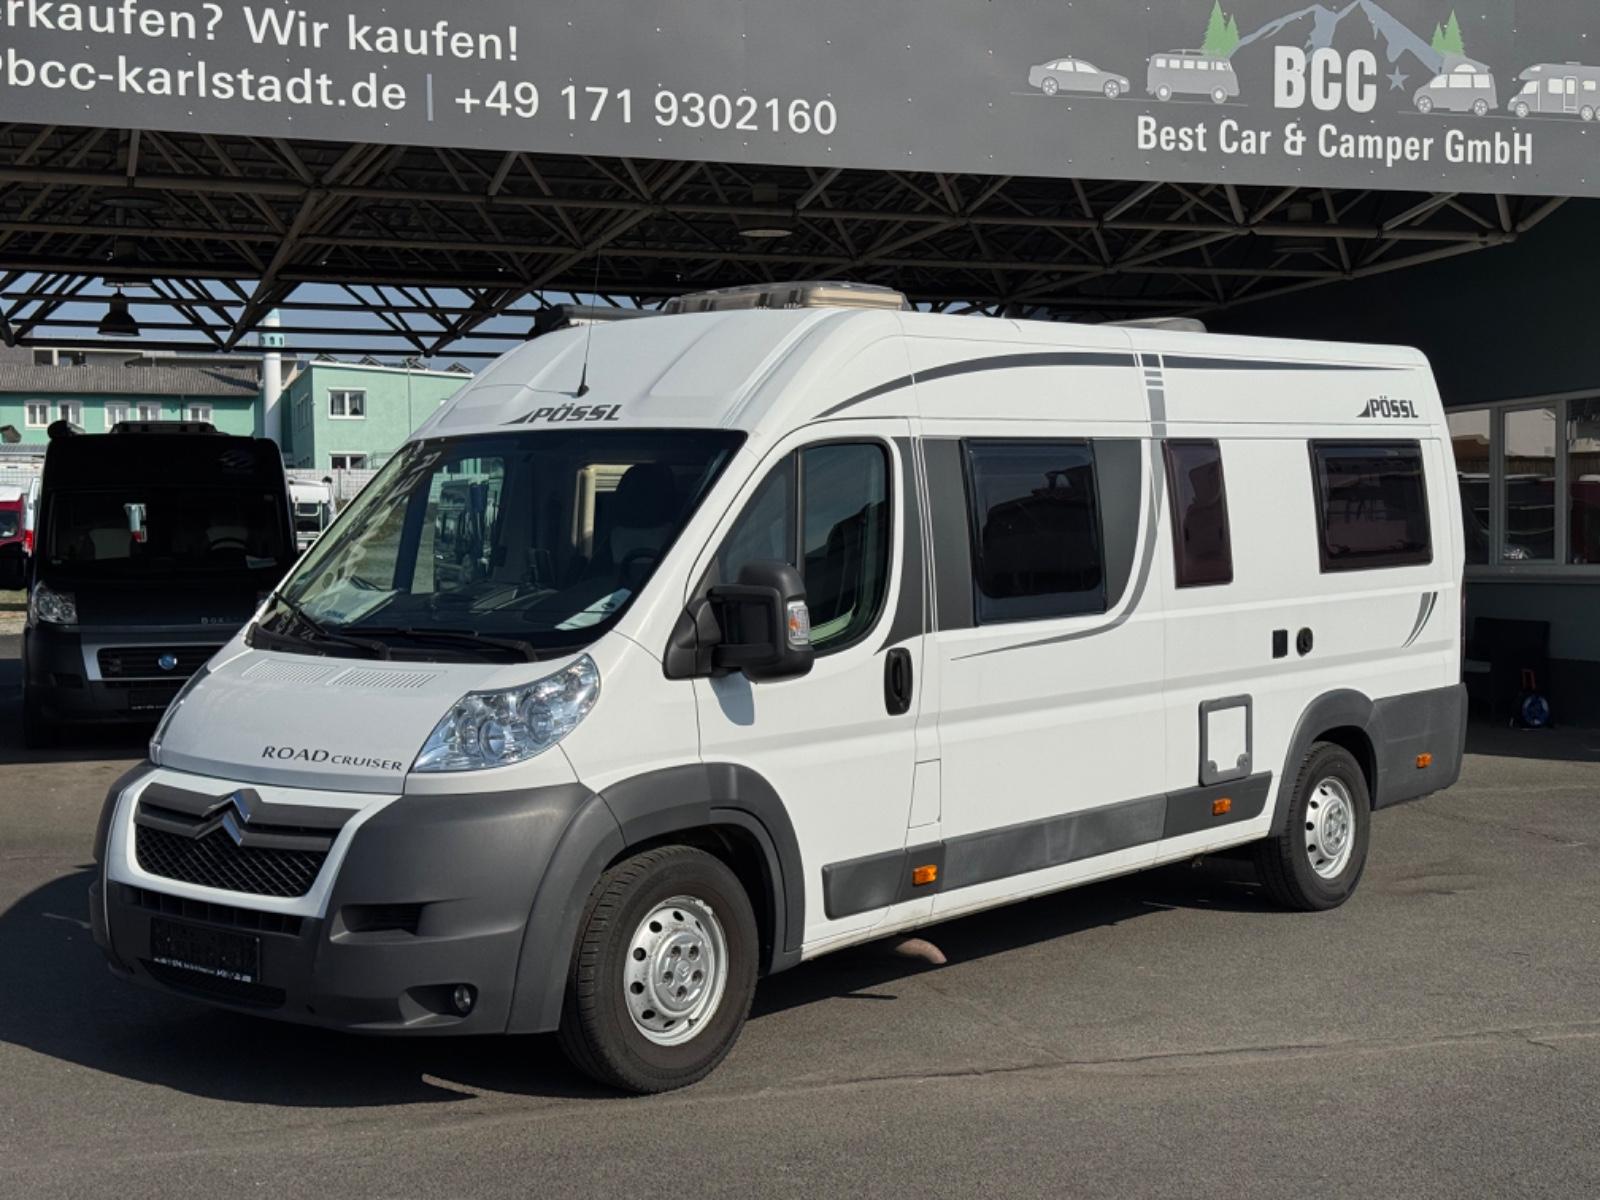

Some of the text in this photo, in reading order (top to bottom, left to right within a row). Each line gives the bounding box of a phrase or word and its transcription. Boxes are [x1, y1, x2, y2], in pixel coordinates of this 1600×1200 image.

[0, 0, 517, 61] rkaufen? Wir kaufen!
[0, 48, 837, 135] bcc-karlstadt.de +49 171 9302160
[1274, 45, 1377, 112] BCC
[1137, 115, 1533, 167] Best Car & Camper GmbH
[527, 402, 622, 424] PÖSSL
[1369, 395, 1419, 418] PÖSSL
[261, 745, 402, 771] ROAD CRUISER
